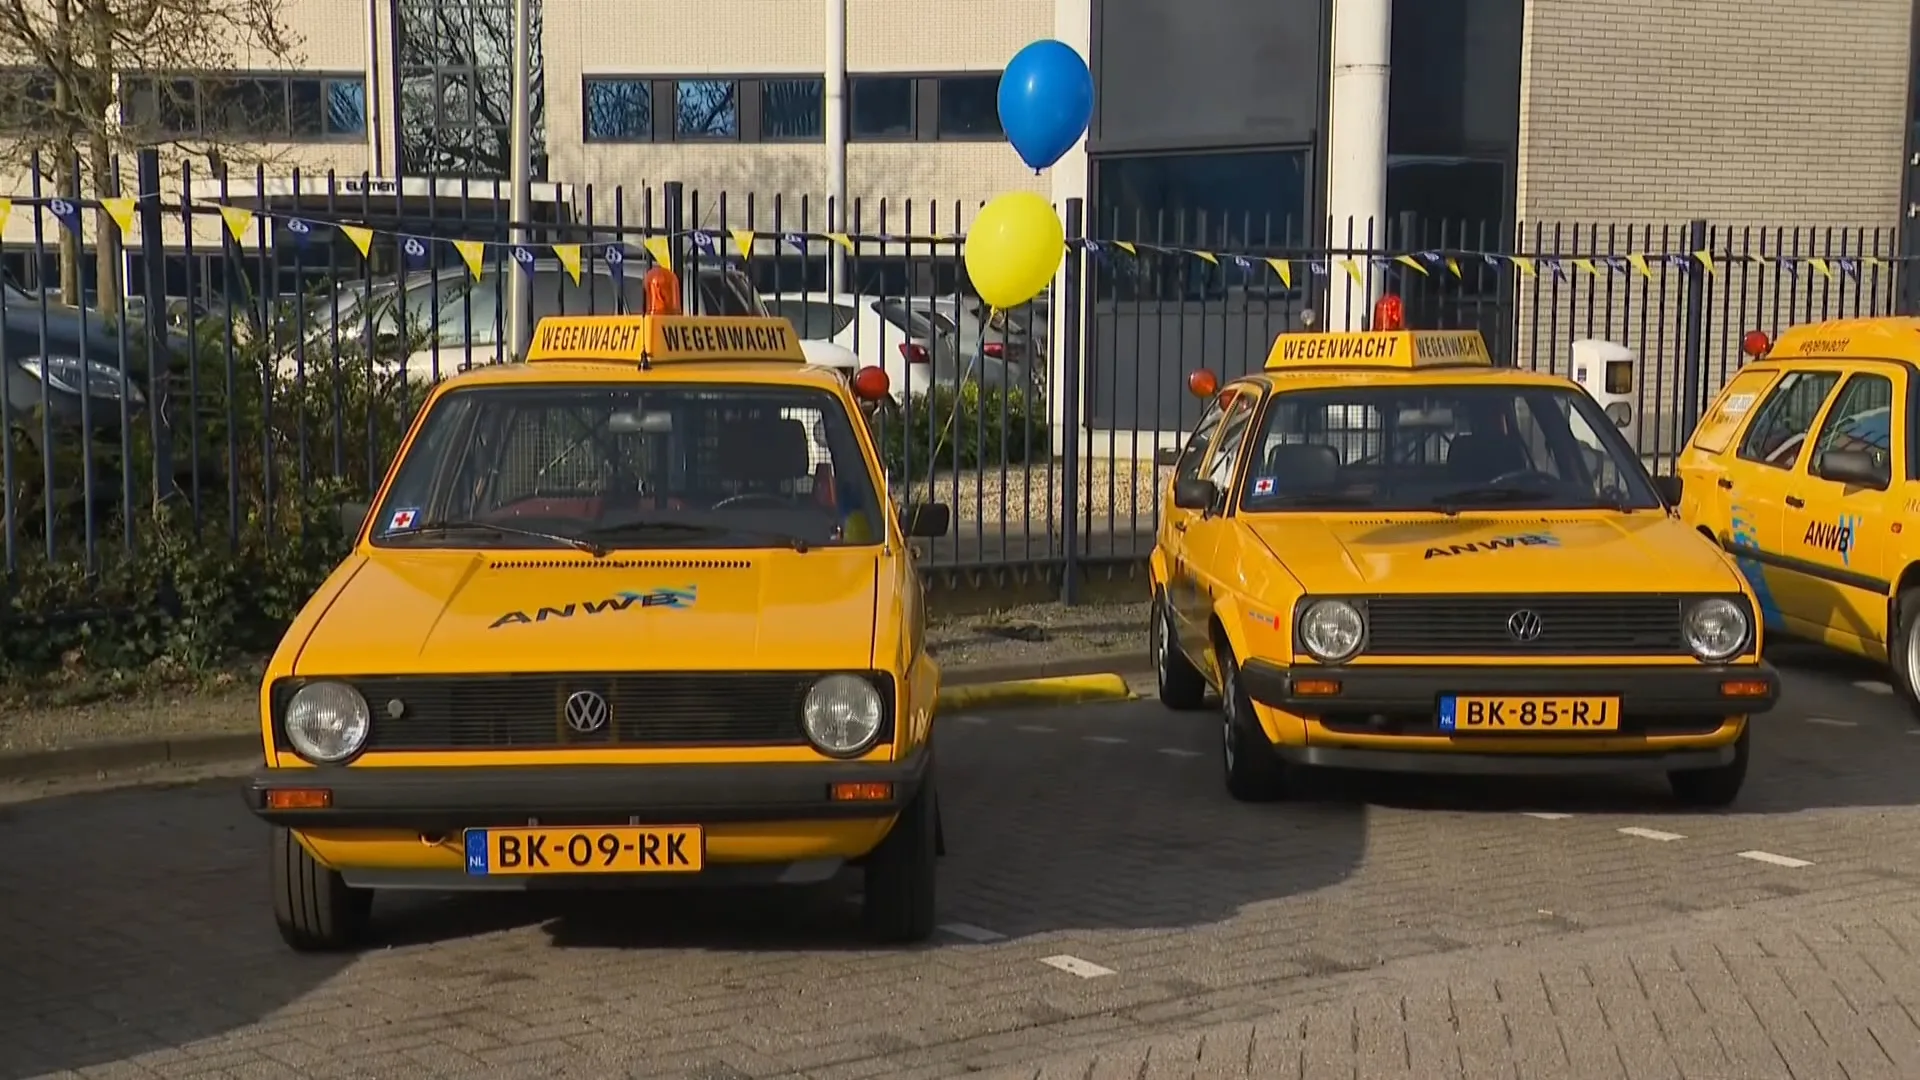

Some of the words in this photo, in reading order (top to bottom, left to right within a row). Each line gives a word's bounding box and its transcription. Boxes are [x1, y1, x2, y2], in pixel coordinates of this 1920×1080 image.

[541, 325, 640, 350] WEGENWACHT
[662, 325, 788, 352] WEGENWACHT
[1284, 336, 1398, 360] WEGENWACHT
[1415, 335, 1481, 358] WEGENWACHT
[1424, 534, 1549, 560] ANWB
[1803, 520, 1850, 553] ANWB
[487, 592, 679, 630] ANWB
[1466, 700, 1608, 726] BK-85-RJ
[469, 856, 485, 867] NL
[498, 832, 690, 868] BK-09-RK
